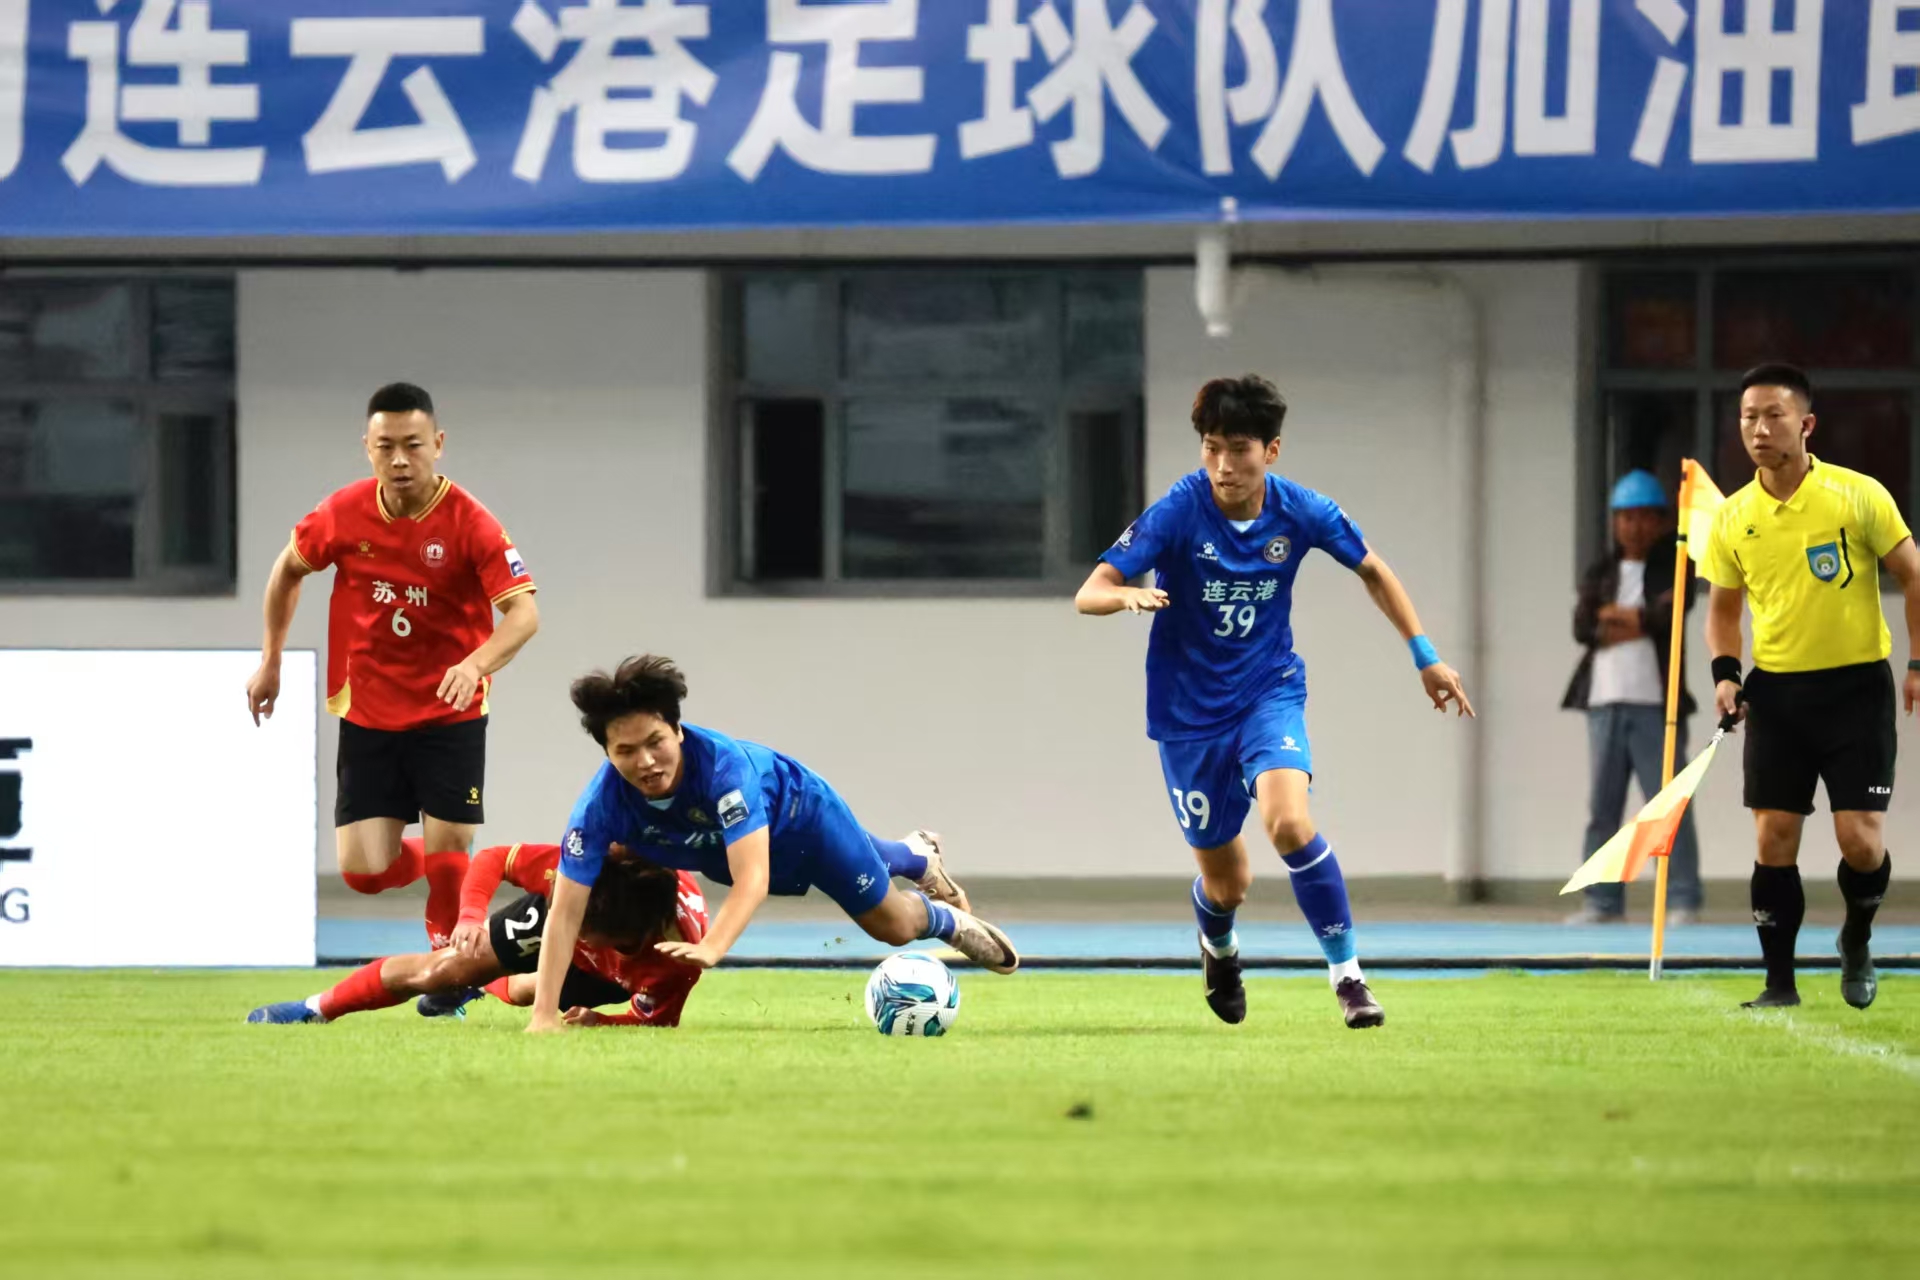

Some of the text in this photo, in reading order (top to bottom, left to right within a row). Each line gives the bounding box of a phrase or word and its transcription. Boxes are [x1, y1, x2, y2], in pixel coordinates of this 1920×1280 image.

[0, 0, 1920, 186] 连云港足球队加油
[372, 580, 428, 606] 苏州
[1202, 579, 1278, 602] 连云港
[391, 608, 412, 637] 6
[1213, 605, 1256, 638] 39
[1173, 788, 1210, 830] 39
[0, 887, 30, 924] G
